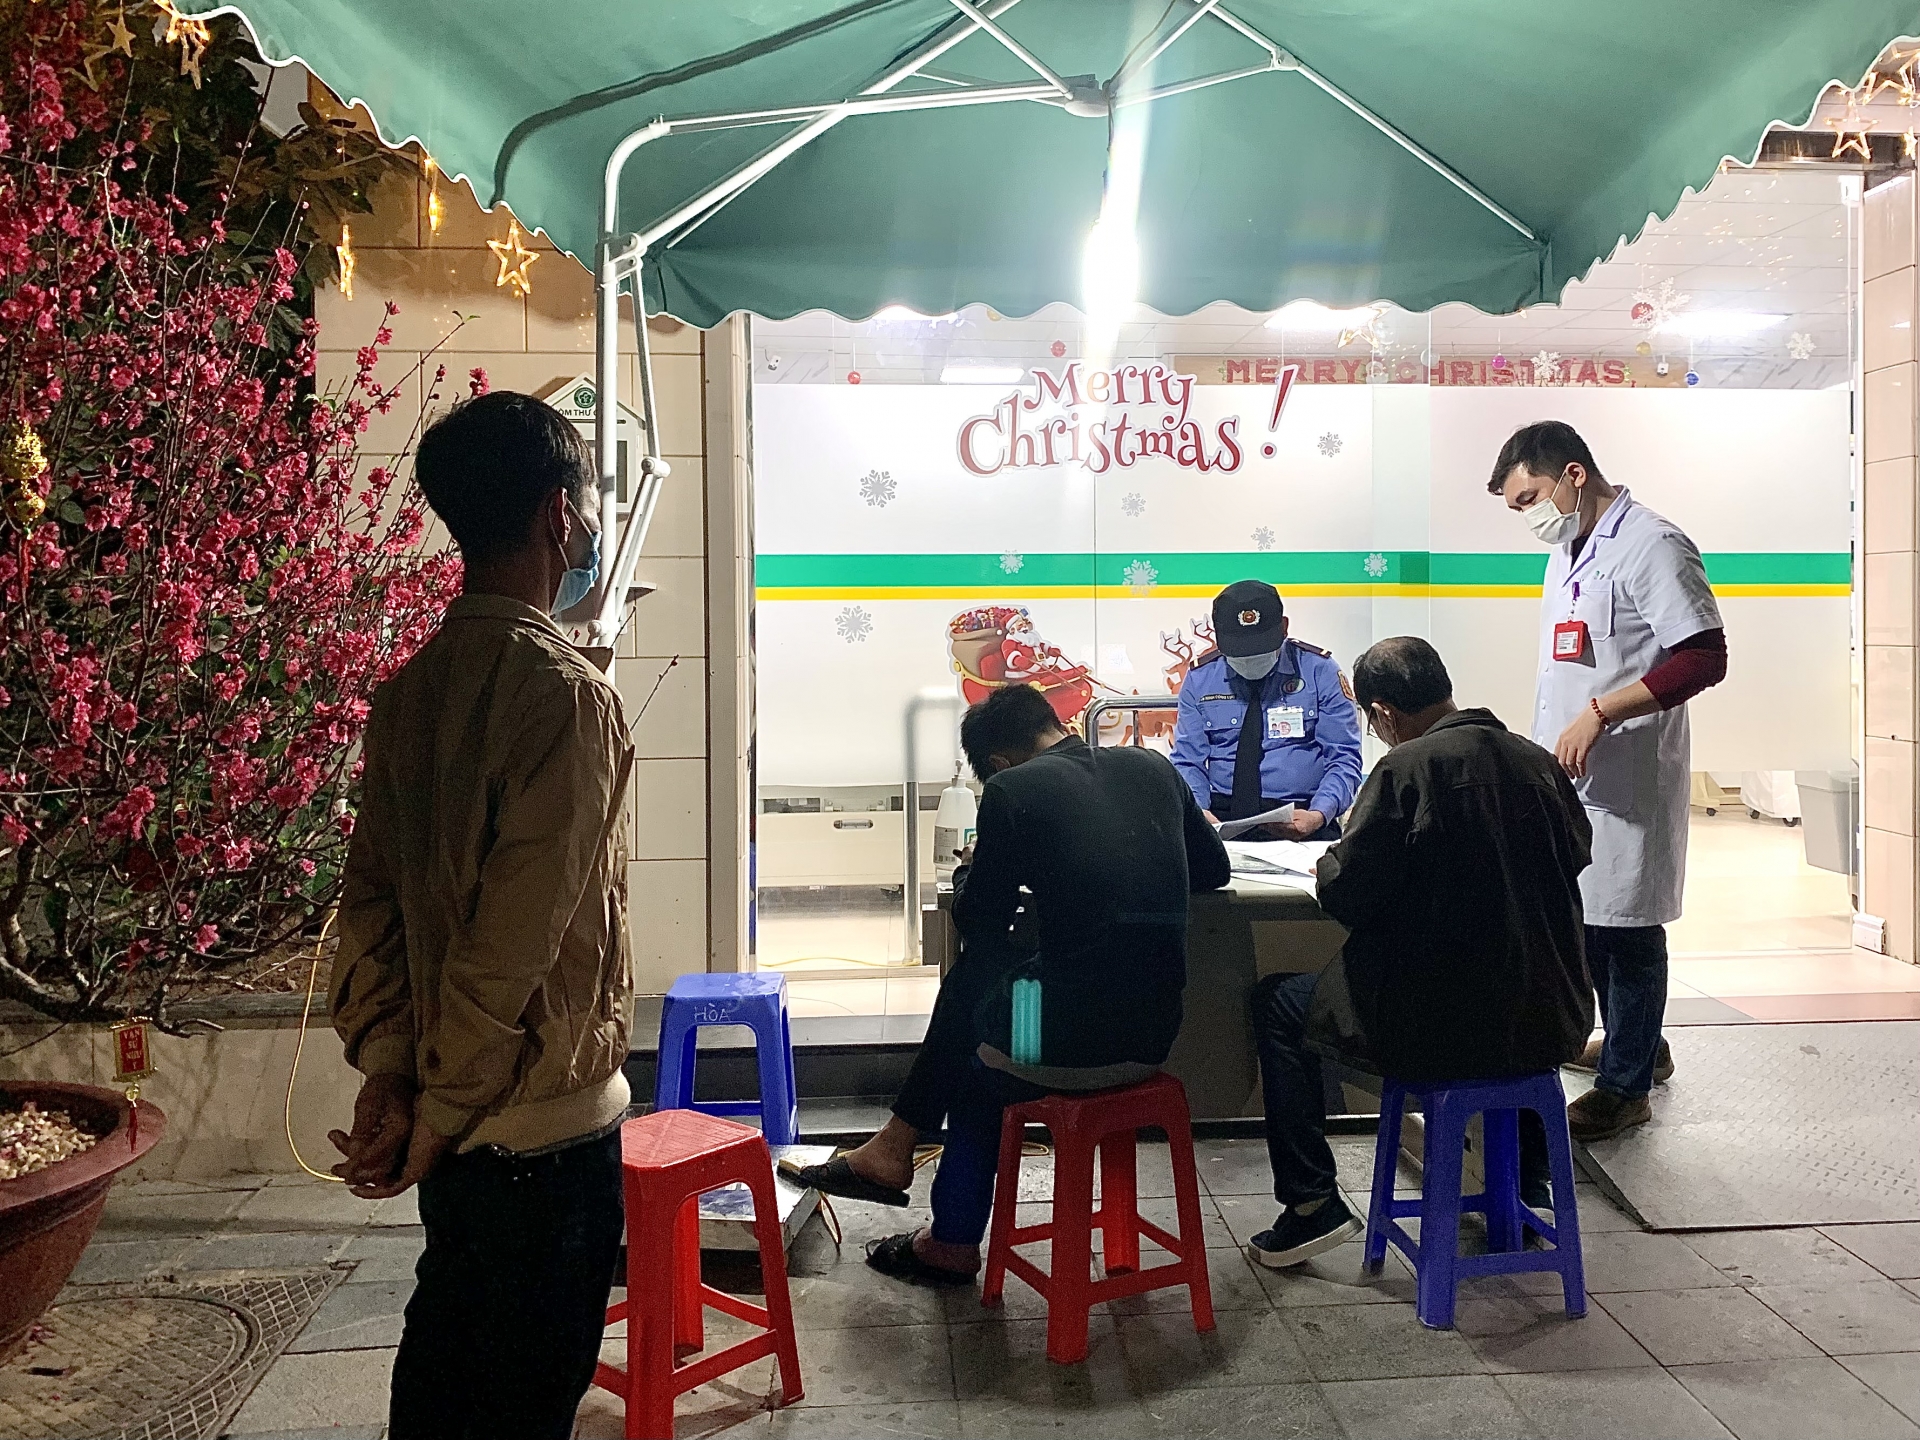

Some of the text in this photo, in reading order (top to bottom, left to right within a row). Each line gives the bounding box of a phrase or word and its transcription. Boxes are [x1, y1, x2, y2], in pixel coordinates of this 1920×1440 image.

[1226, 358, 1363, 384] MERRY
[1023, 362, 1194, 430] Merry
[555, 408, 572, 416] ÒM
[958, 392, 1242, 473] Christmas
[694, 1002, 731, 1022] HÒA
